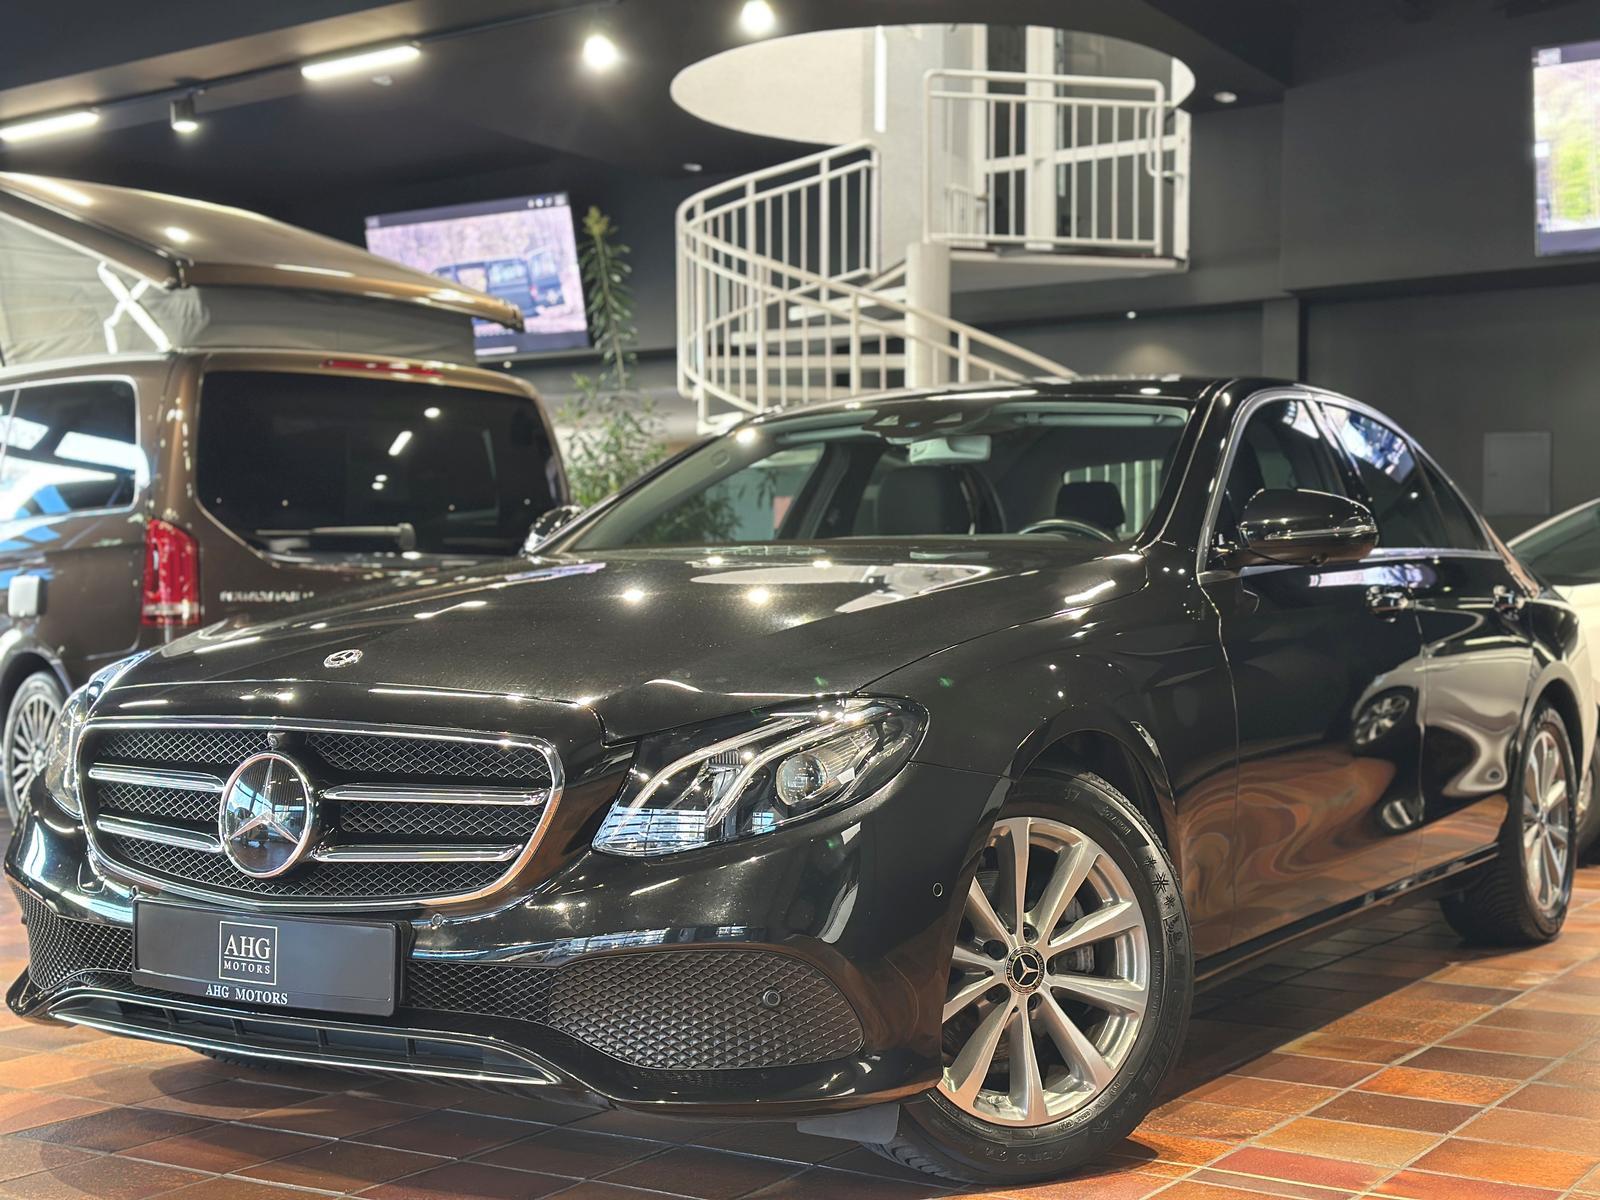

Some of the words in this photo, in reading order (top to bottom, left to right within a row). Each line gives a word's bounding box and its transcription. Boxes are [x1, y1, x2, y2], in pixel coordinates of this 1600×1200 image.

[223, 934, 271, 959] AHG
[223, 960, 270, 974] MOTORS
[205, 983, 230, 998] AHG
[235, 987, 288, 1005] MOTORS
